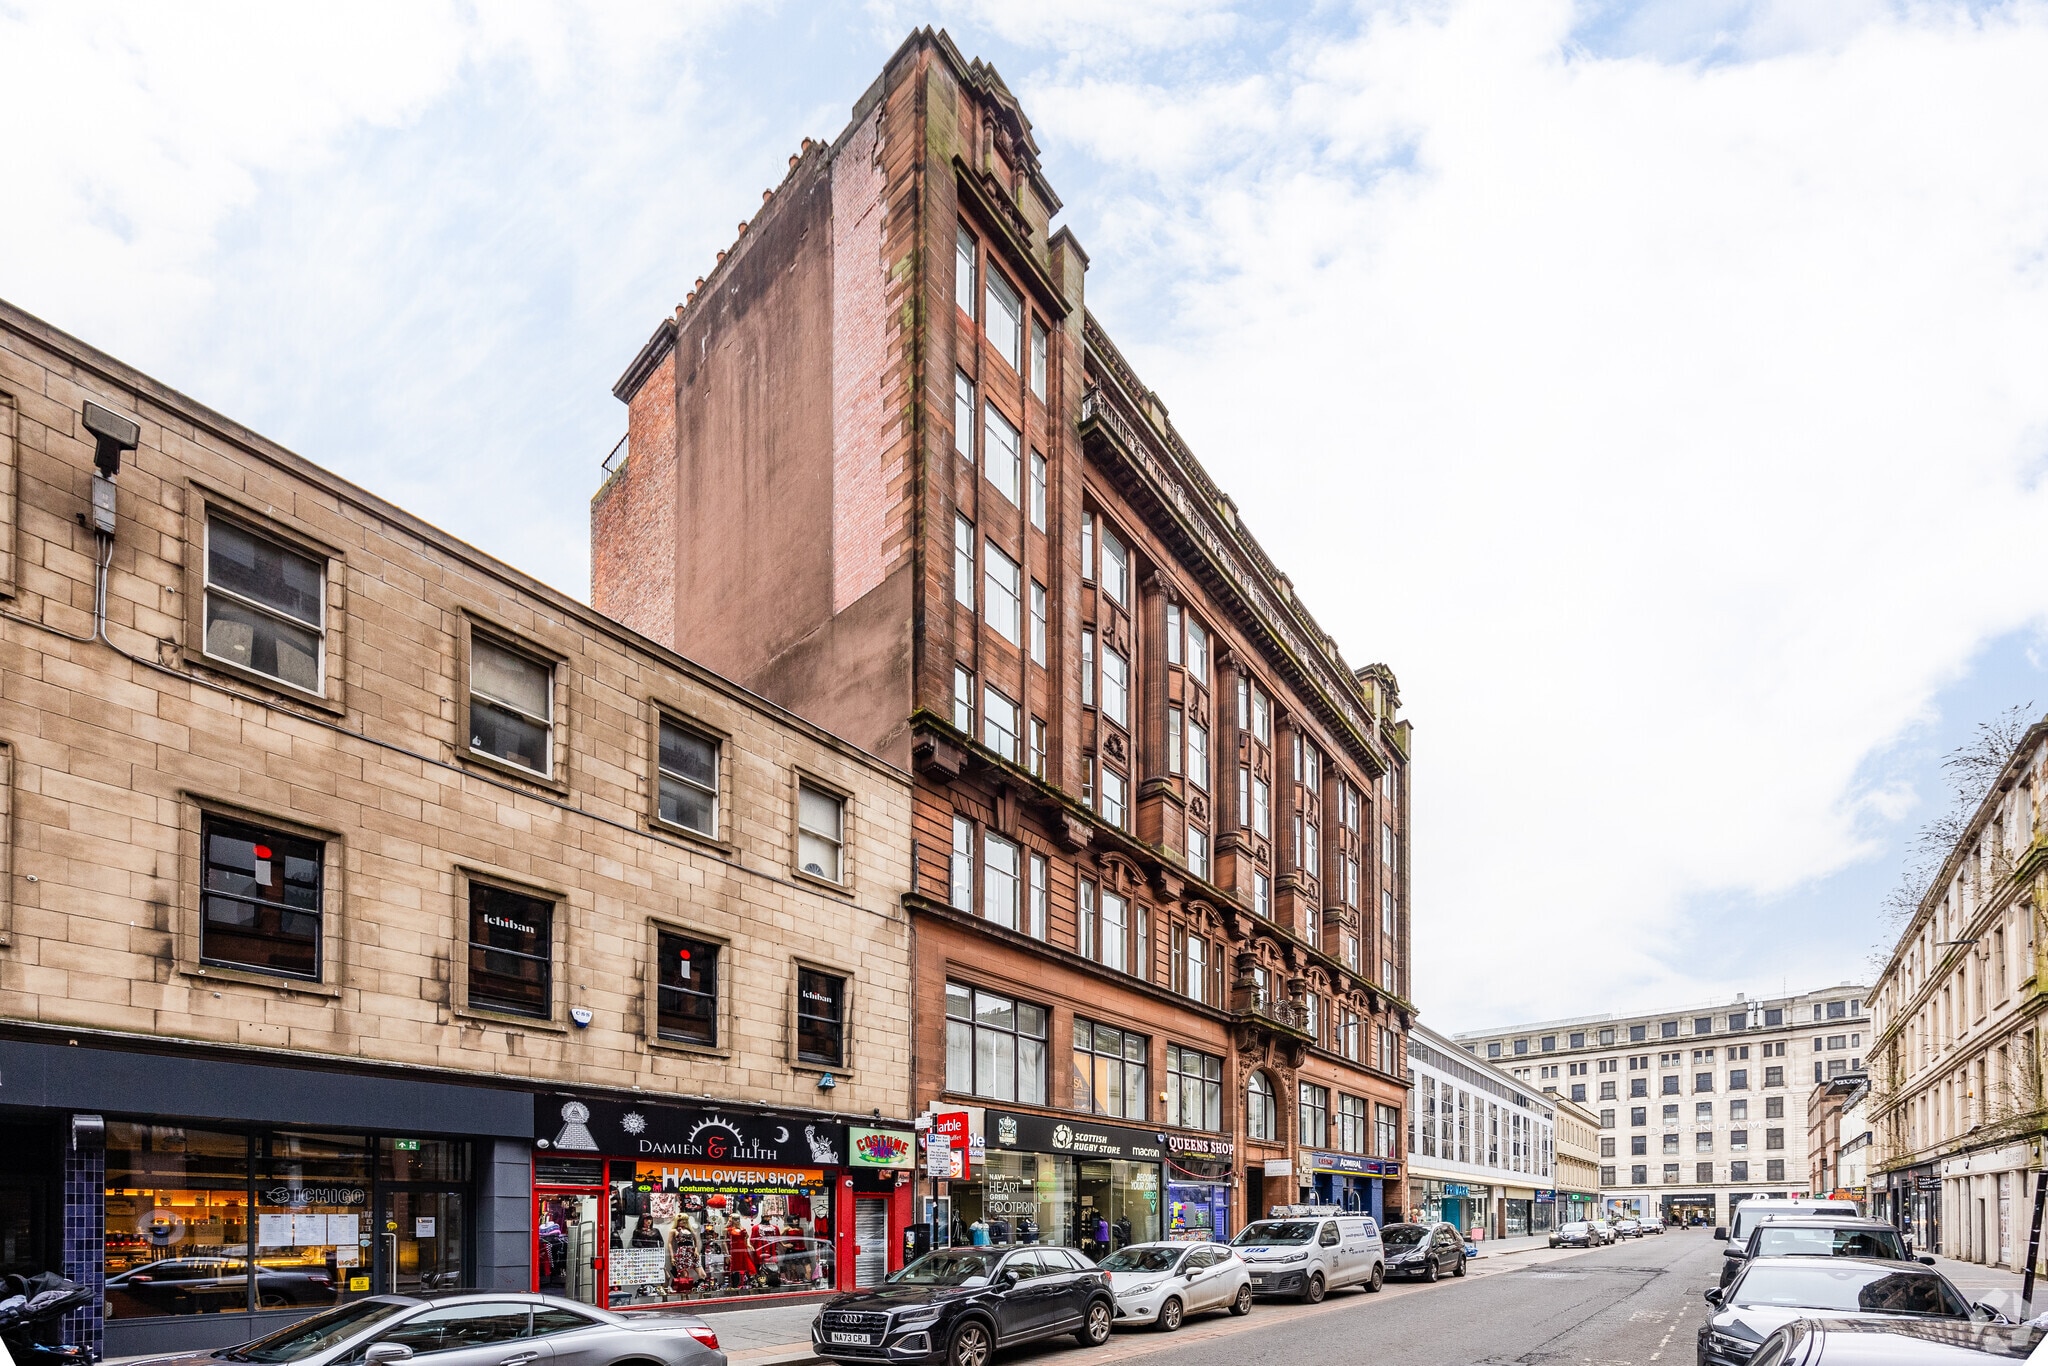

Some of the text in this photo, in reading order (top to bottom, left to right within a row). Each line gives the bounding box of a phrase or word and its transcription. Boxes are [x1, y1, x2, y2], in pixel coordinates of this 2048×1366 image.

[484, 914, 535, 933] Ichiban
[803, 990, 832, 1003] Ichiban
[1650, 1120, 1775, 1135] DEBENHAMS
[1075, 1133, 1108, 1144] SCOTTISH
[639, 1136, 777, 1160] DAMIEN & LILITH
[856, 1135, 909, 1155] COSTUME
[1073, 1143, 1121, 1155] RUGBY STORE
[1169, 1136, 1234, 1155] QUEENS SHOP
[1132, 1146, 1159, 1158] macron
[1339, 1158, 1362, 1169] ADMIRAL
[662, 1167, 805, 1189] HALLOWEEN SHOP
[1136, 1173, 1157, 1181] BECOME
[679, 1185, 715, 1193] costumes
[989, 1182, 1020, 1193] HEART
[1130, 1181, 1157, 1191] YOUR OWN
[1445, 1184, 1469, 1195] PRIMARK
[294, 1188, 365, 1204] ICHIGO
[989, 1201, 1041, 1213] FOOTPRINT
[834, 1333, 868, 1343] NA73 CRJ
